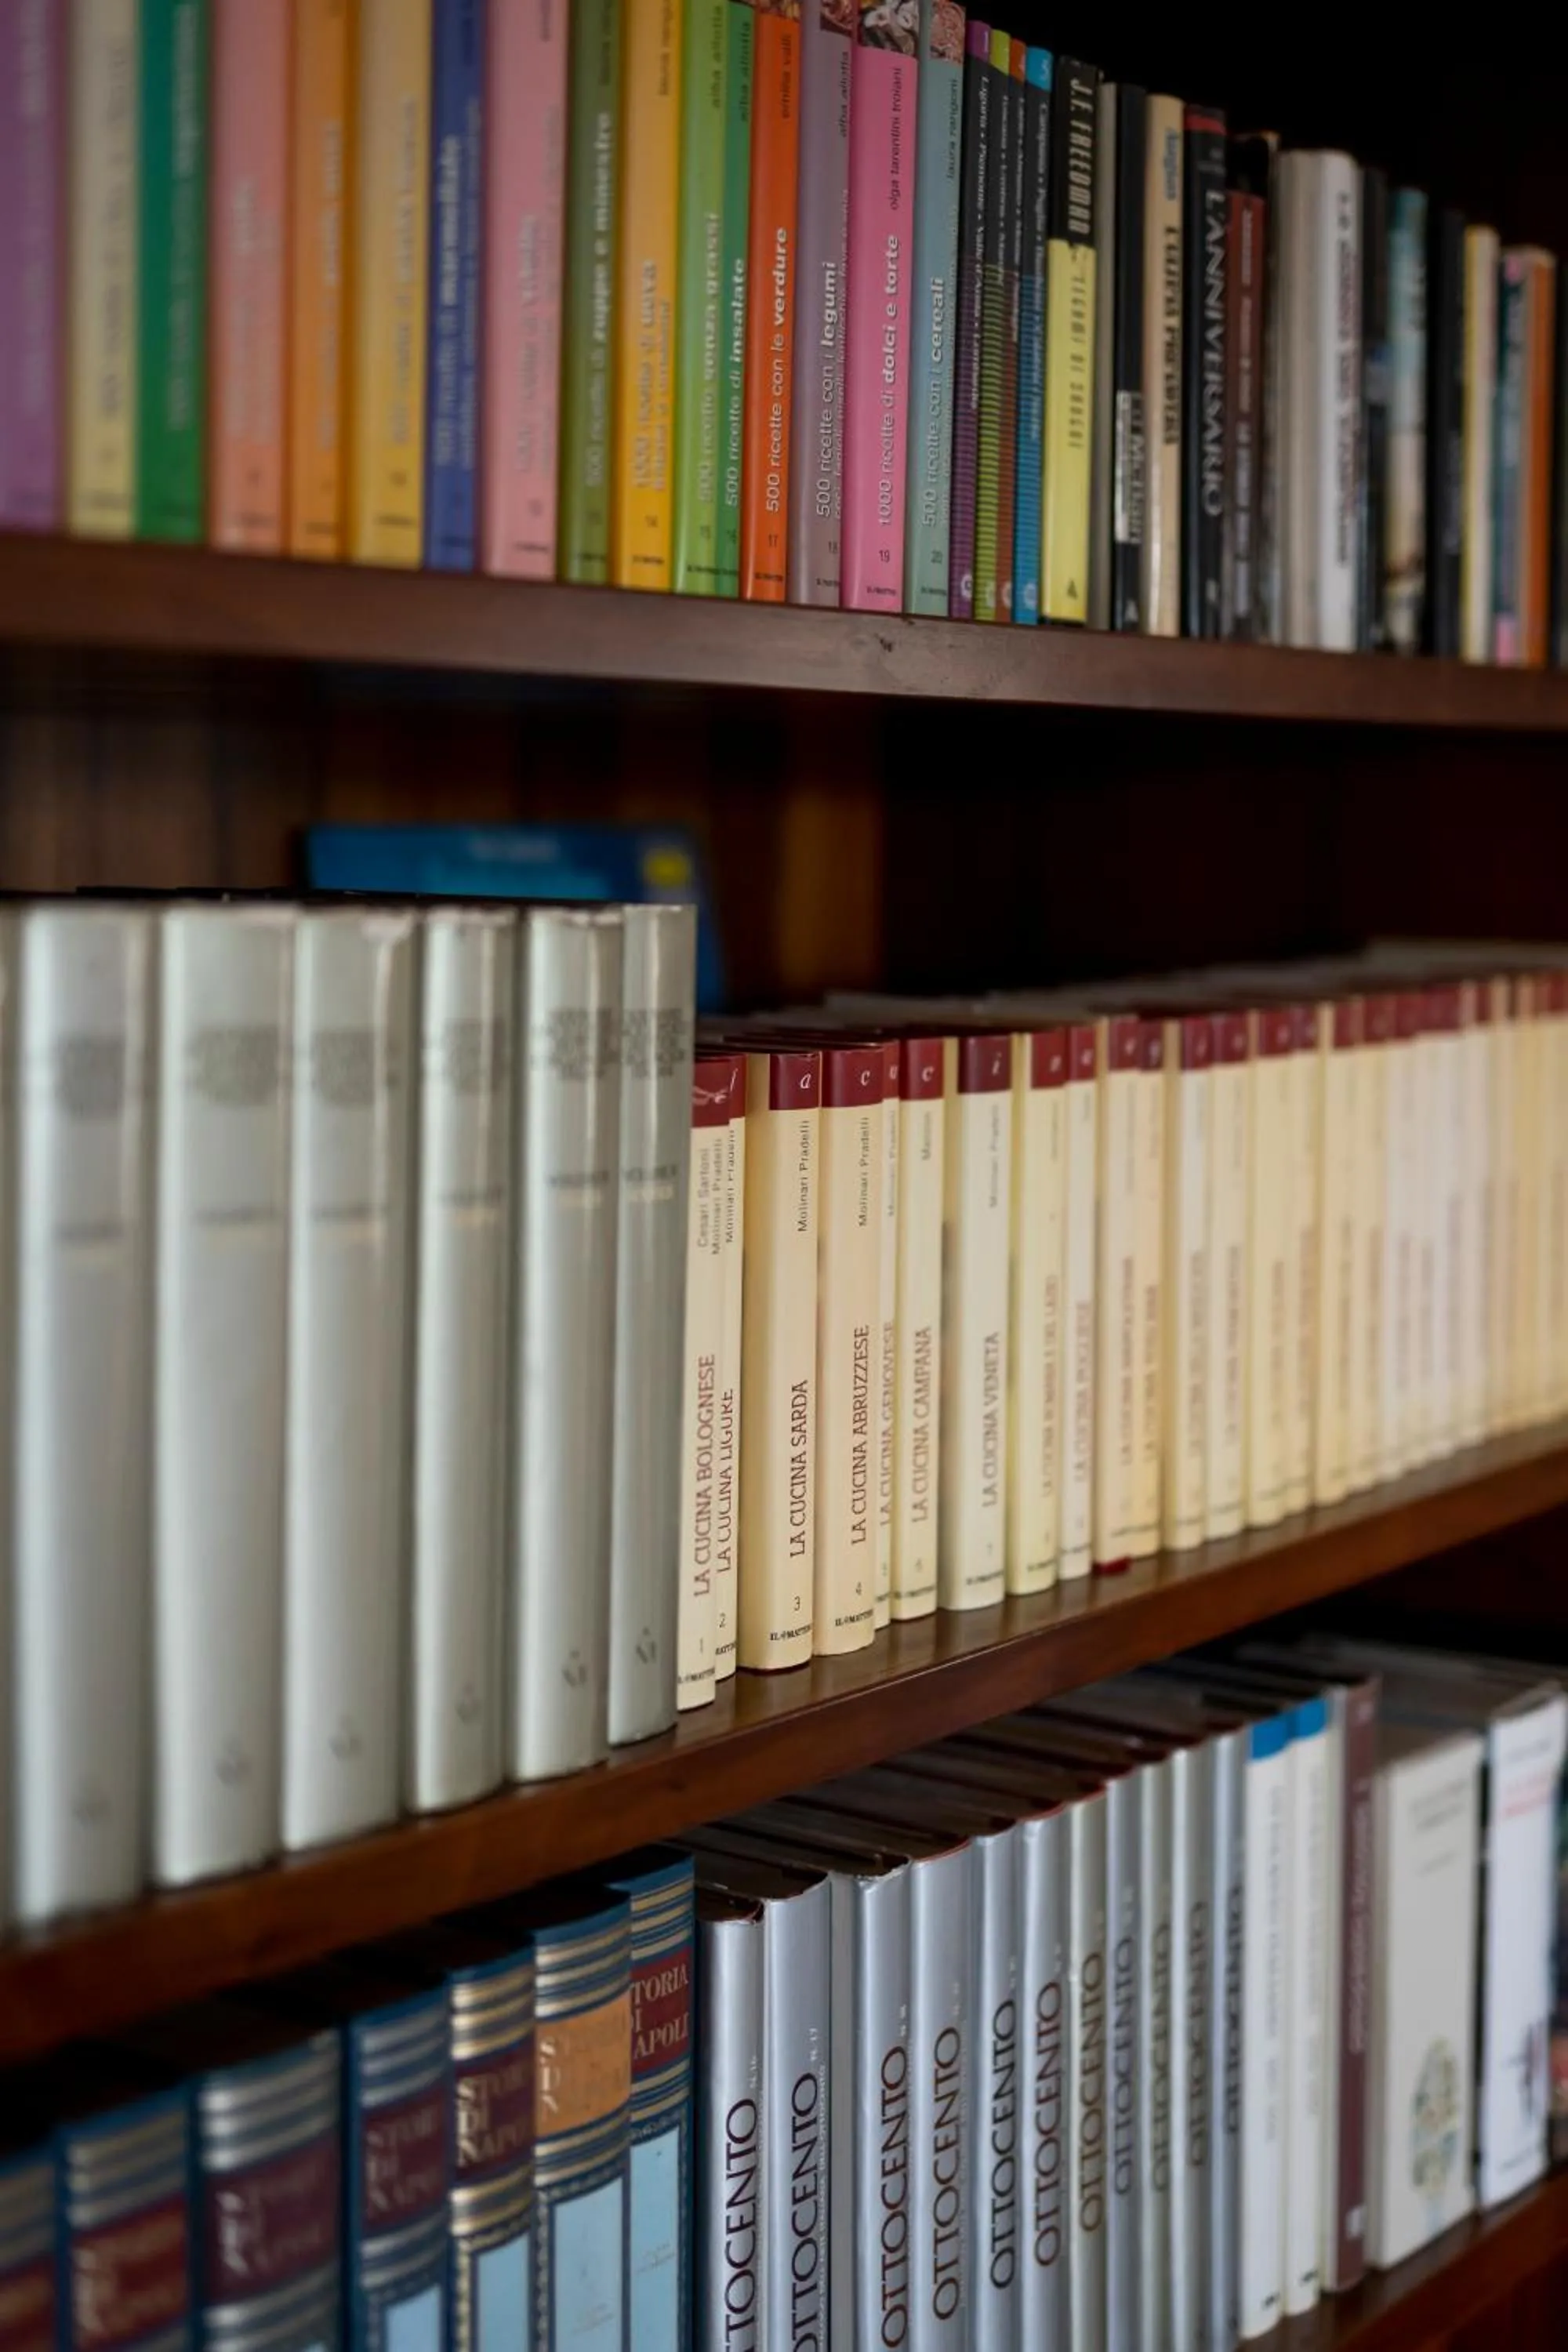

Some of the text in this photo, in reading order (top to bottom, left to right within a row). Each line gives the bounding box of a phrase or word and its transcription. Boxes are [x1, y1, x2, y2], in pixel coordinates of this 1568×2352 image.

[886, 67, 903, 211] olga tarentini troiani
[946, 136, 956, 180] laura
[978, 76, 989, 129] Liguria
[593, 111, 612, 232] minestre
[1066, 119, 1094, 235] FREEDMAN
[590, 262, 610, 342] zuppe
[593, 238, 609, 256] e
[820, 260, 837, 347] legumi
[765, 227, 788, 513] 500 ricette con le verdure
[930, 277, 944, 363] cereali
[1200, 189, 1225, 517] L'ANNIVERSARIO
[725, 258, 746, 506] 500 ricette di insalate
[822, 362, 835, 403] con
[877, 234, 899, 526] 1000 ricette di dolci e torte
[927, 379, 941, 416] con
[816, 477, 831, 518] 500
[818, 409, 833, 474] ricette
[924, 419, 940, 484] ricette
[878, 549, 891, 564] 19
[921, 486, 937, 528] 500
[800, 1073, 812, 1090] a
[860, 1069, 872, 1087] c
[920, 1065, 935, 1082] c
[696, 1203, 710, 1249] Cesari
[711, 1138, 724, 1256] Molinari Pradelli
[797, 1119, 811, 1233] Molinari Pradelli
[858, 1116, 870, 1228] Molinari Pradelli
[692, 1353, 716, 1598] LA CUCINA BOLOGNESE
[789, 1379, 808, 1559] LA CUCINA SARDA
[850, 1324, 870, 1546] LA CUCINA ABRUZZESE
[879, 1320, 895, 1528] LA CUCINA GENOVESE
[910, 1325, 933, 1523] LA CUCINA CAMPANA
[981, 1331, 1001, 1508] LA CUCINA VENETA
[716, 1388, 734, 1574] LA CUCINA LIGURE
[718, 1612, 727, 1628] 2
[793, 1595, 801, 1612] 3
[855, 1581, 862, 1596] 4
[630, 1962, 689, 2005] TORIA
[633, 2011, 690, 2060] APOLI
[1079, 1951, 1104, 2234] OTTOCENTO
[1113, 1934, 1134, 2195] OTTOCENTO
[1149, 1922, 1171, 2194] OTTOCENTO
[932, 2027, 961, 2321] OTTOCENTO
[989, 1998, 1017, 2289] OTTOCENTO
[1033, 1981, 1062, 2268] OTTOCENTO
[724, 2098, 758, 2352] TOCENTO
[880, 2045, 908, 2349] OTTOCENTO
